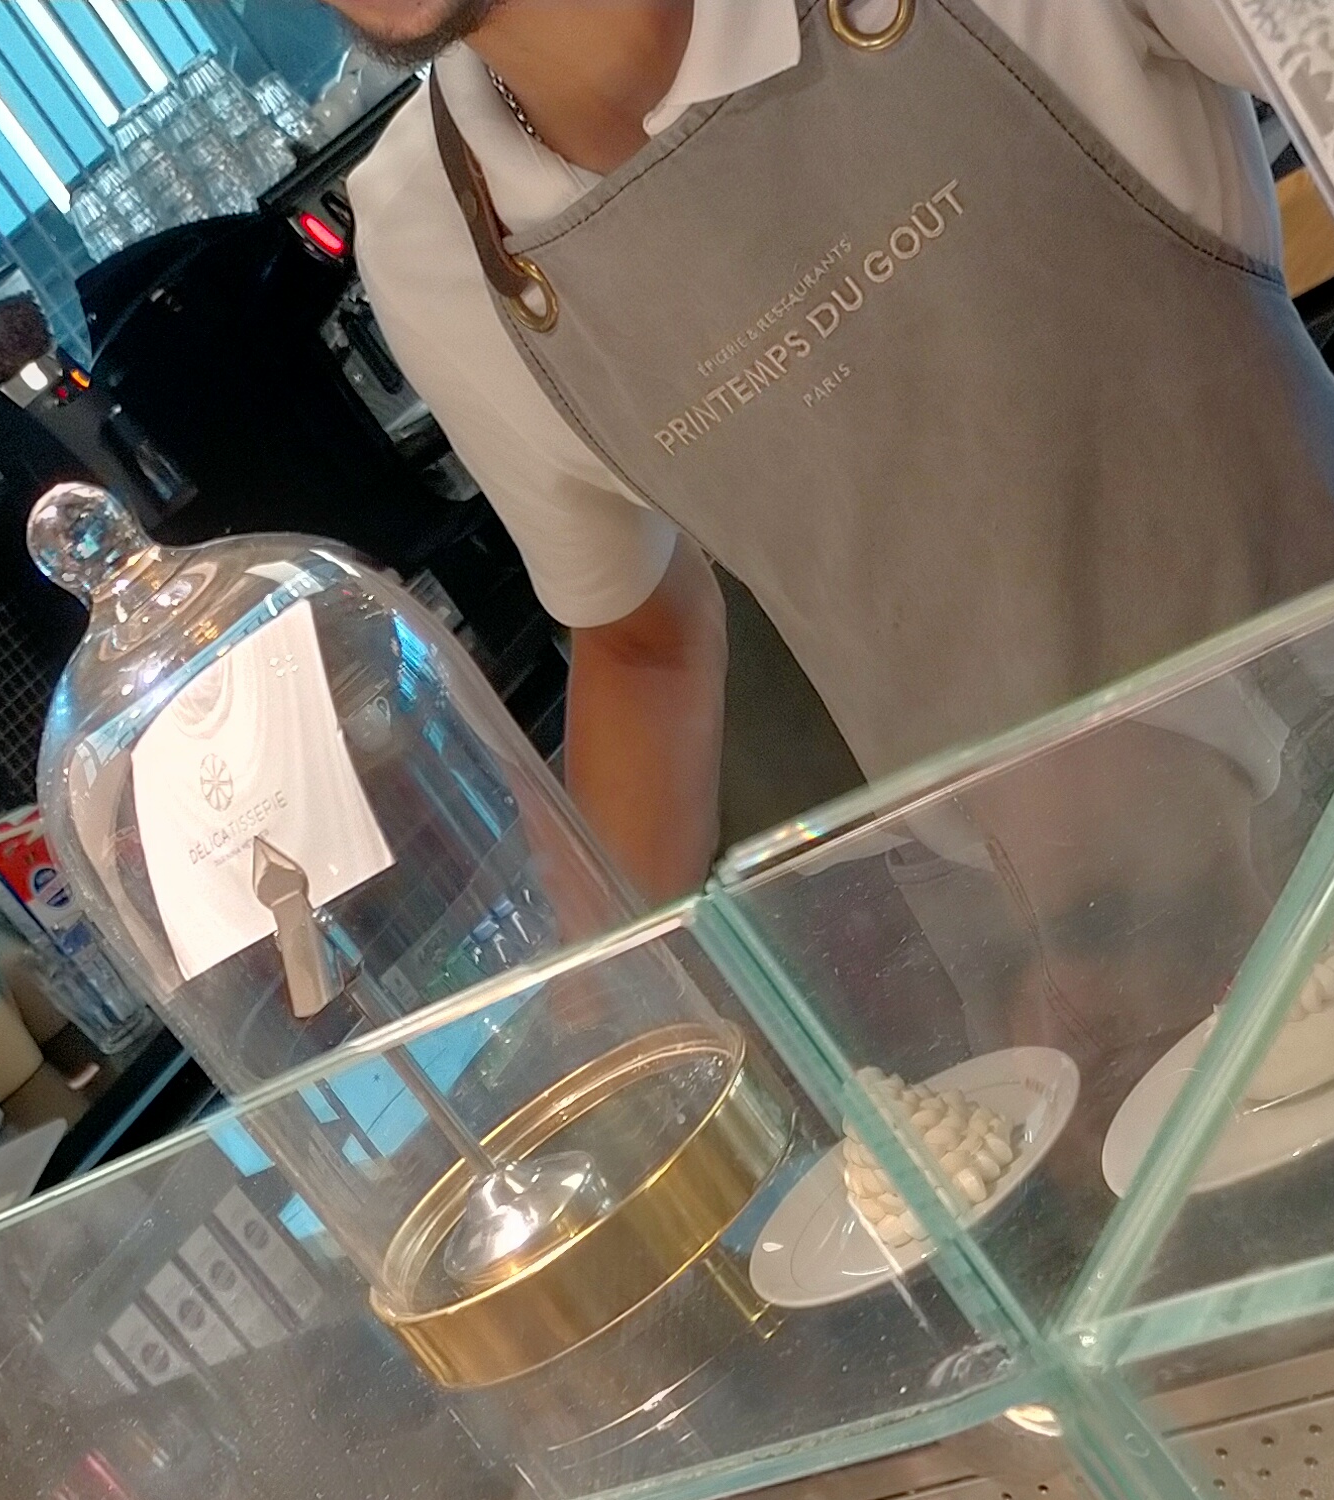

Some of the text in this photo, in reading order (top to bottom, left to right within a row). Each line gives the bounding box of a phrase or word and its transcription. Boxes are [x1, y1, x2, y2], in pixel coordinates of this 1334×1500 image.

[756, 237, 852, 334] RESTAURANTS
[654, 329, 812, 457] PRINTEMPS
[805, 276, 864, 339] DU
[803, 362, 851, 408] PARIS
[188, 790, 288, 865] DÉLICATISSERIE
